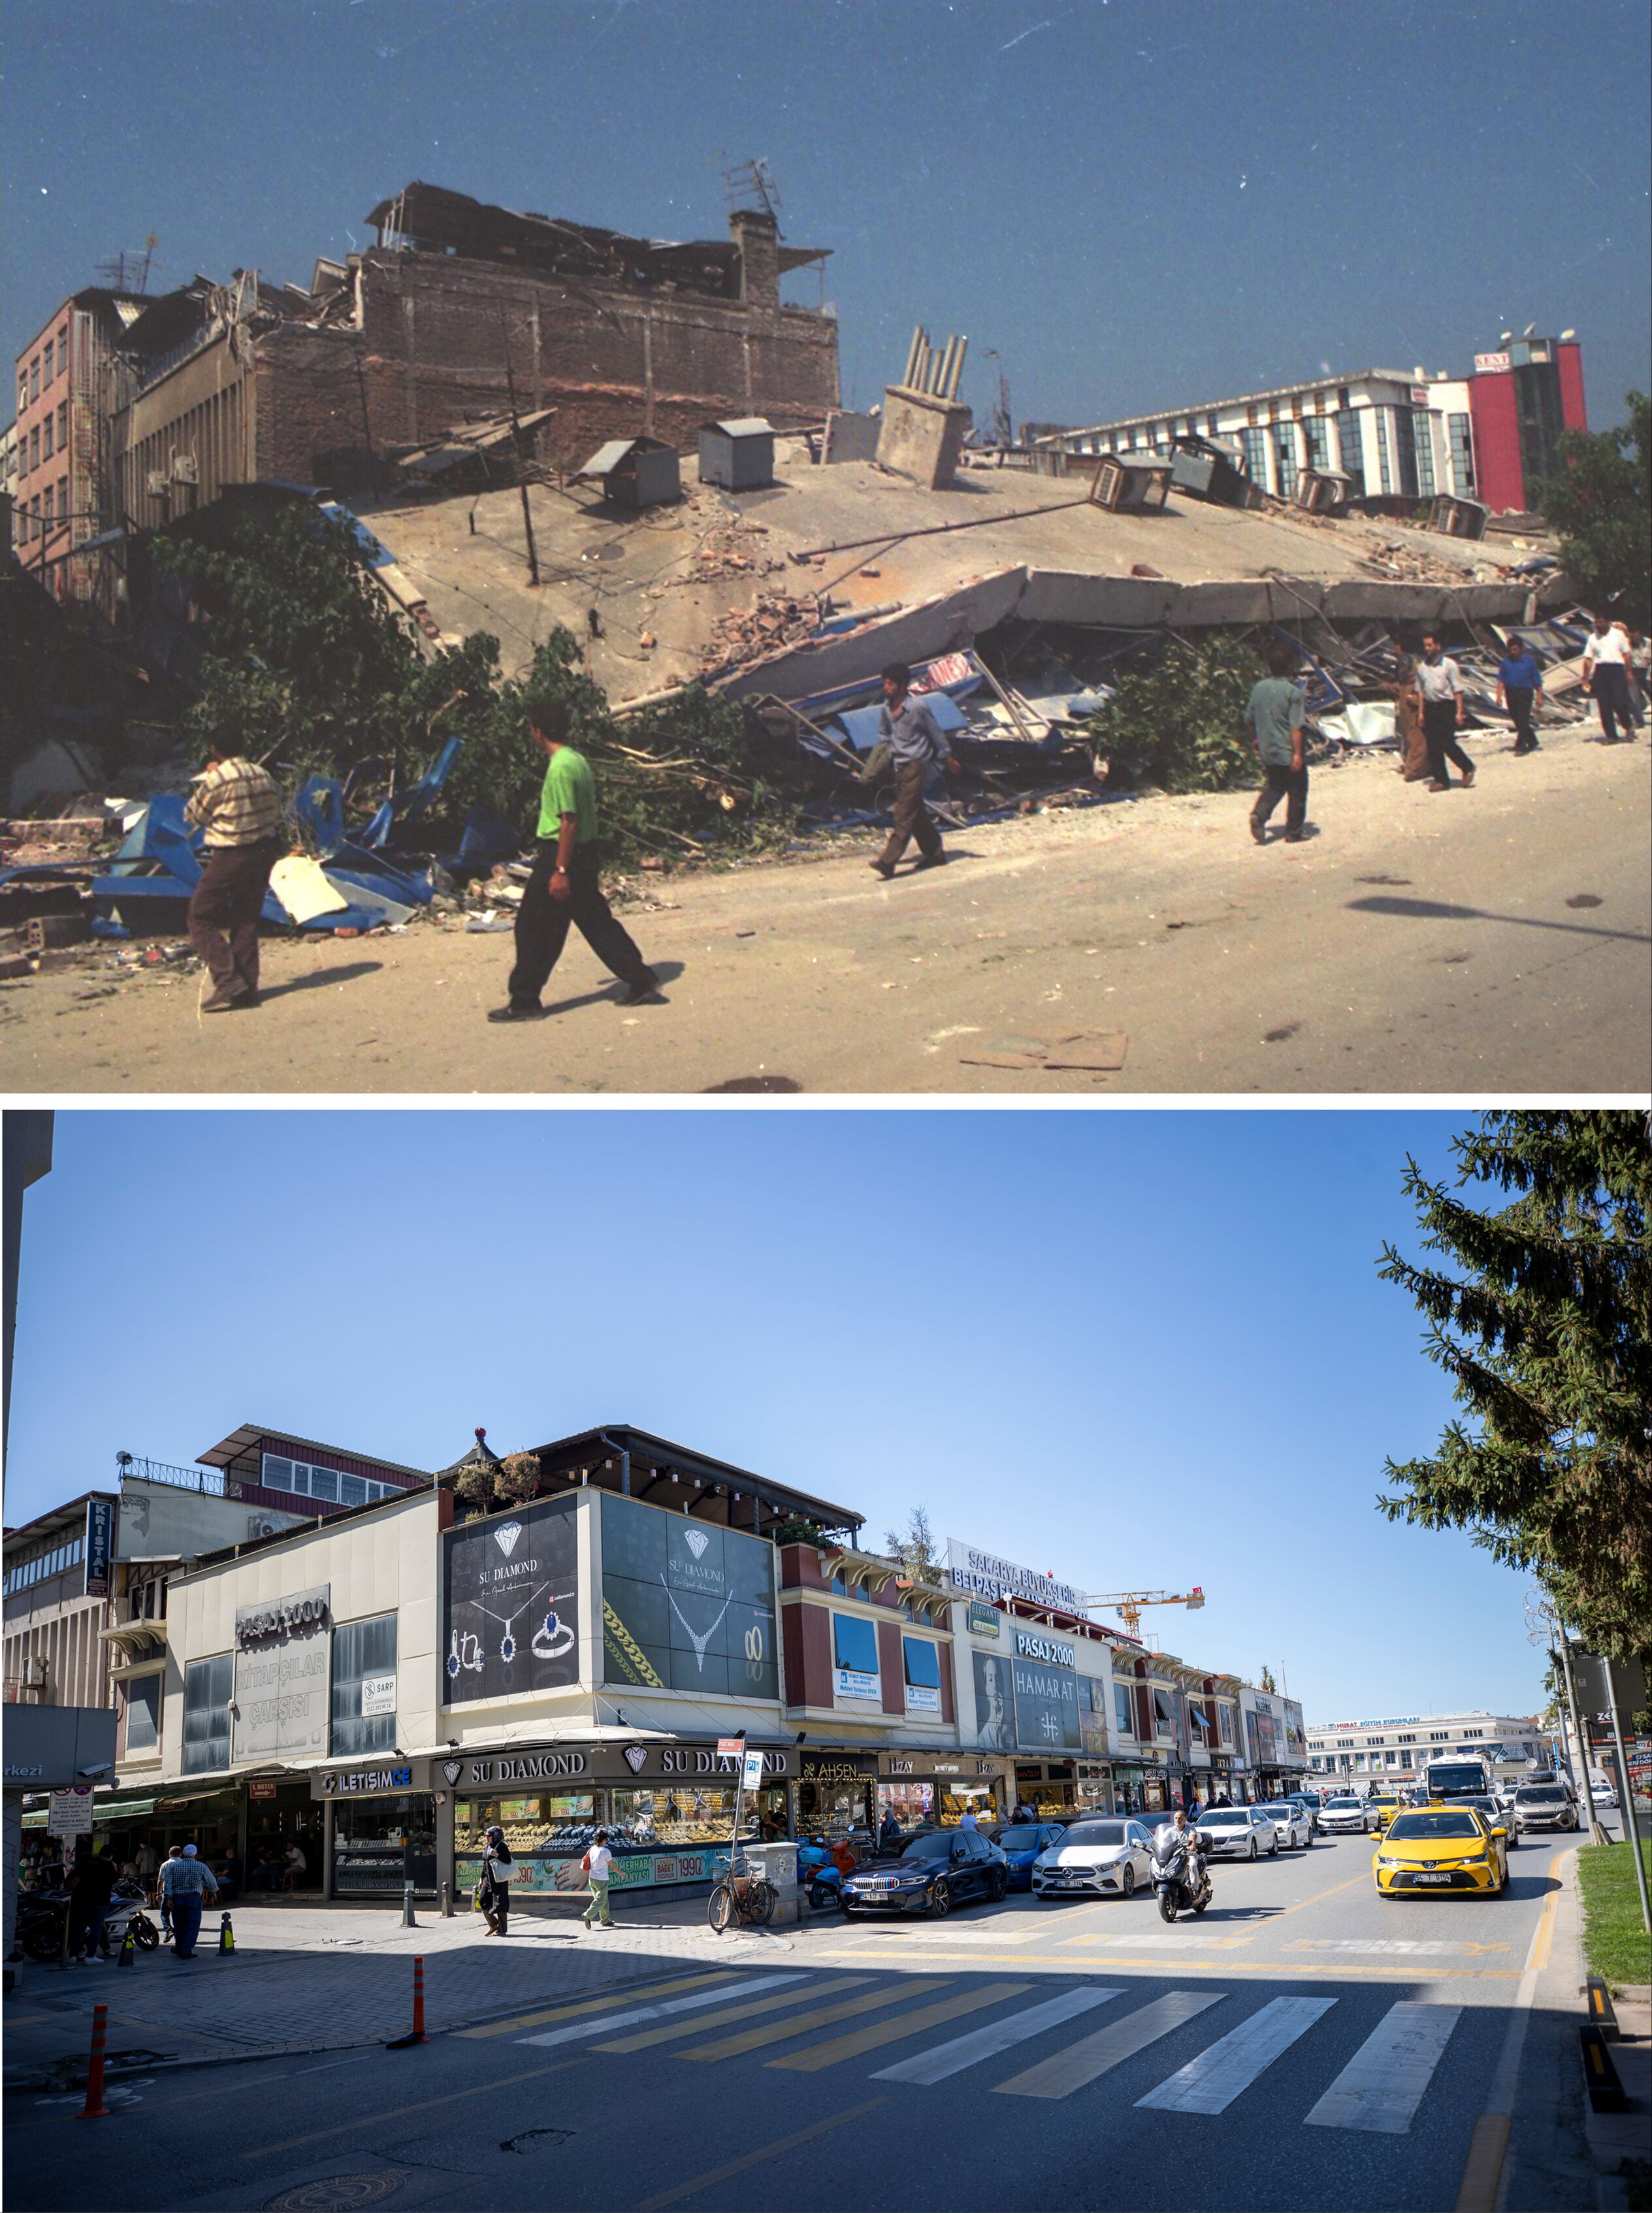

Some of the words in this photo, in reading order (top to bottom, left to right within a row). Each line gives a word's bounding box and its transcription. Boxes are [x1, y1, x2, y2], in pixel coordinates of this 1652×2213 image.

[1475, 355, 1509, 366] KENT
[479, 1571, 489, 1584] SU
[494, 1560, 537, 1581] DIAMOND
[670, 1560, 681, 1572] SU
[685, 1563, 724, 1582] DIAMOND
[969, 1550, 1020, 1584] SAKARYA
[1021, 1569, 1077, 1605] BÜYÜKŞEHİR
[952, 1567, 996, 1601] BELPAŞ
[284, 1598, 323, 1628] 2000
[971, 1603, 1000, 1621] ELEGANTE
[1017, 1635, 1049, 1660] PASAJ
[1051, 1644, 1074, 1666] 2000
[236, 1652, 325, 1691] KİTAPÇILAR
[377, 1682, 393, 1693] SARP
[1016, 1671, 1073, 1701] HAMARAT
[249, 1694, 309, 1731] ÇARŞISI
[3, 1764, 42, 1777] rkezi
[472, 1763, 491, 1783] SU
[498, 1753, 585, 1780] DIAMOND
[663, 1750, 688, 1772] SU
[819, 1764, 856, 1778] AHSEN
[339, 1769, 411, 1790] İLETİŞİMCE
[620, 1856, 653, 1873] MERHABA
[657, 1863, 674, 1873] BAGET
